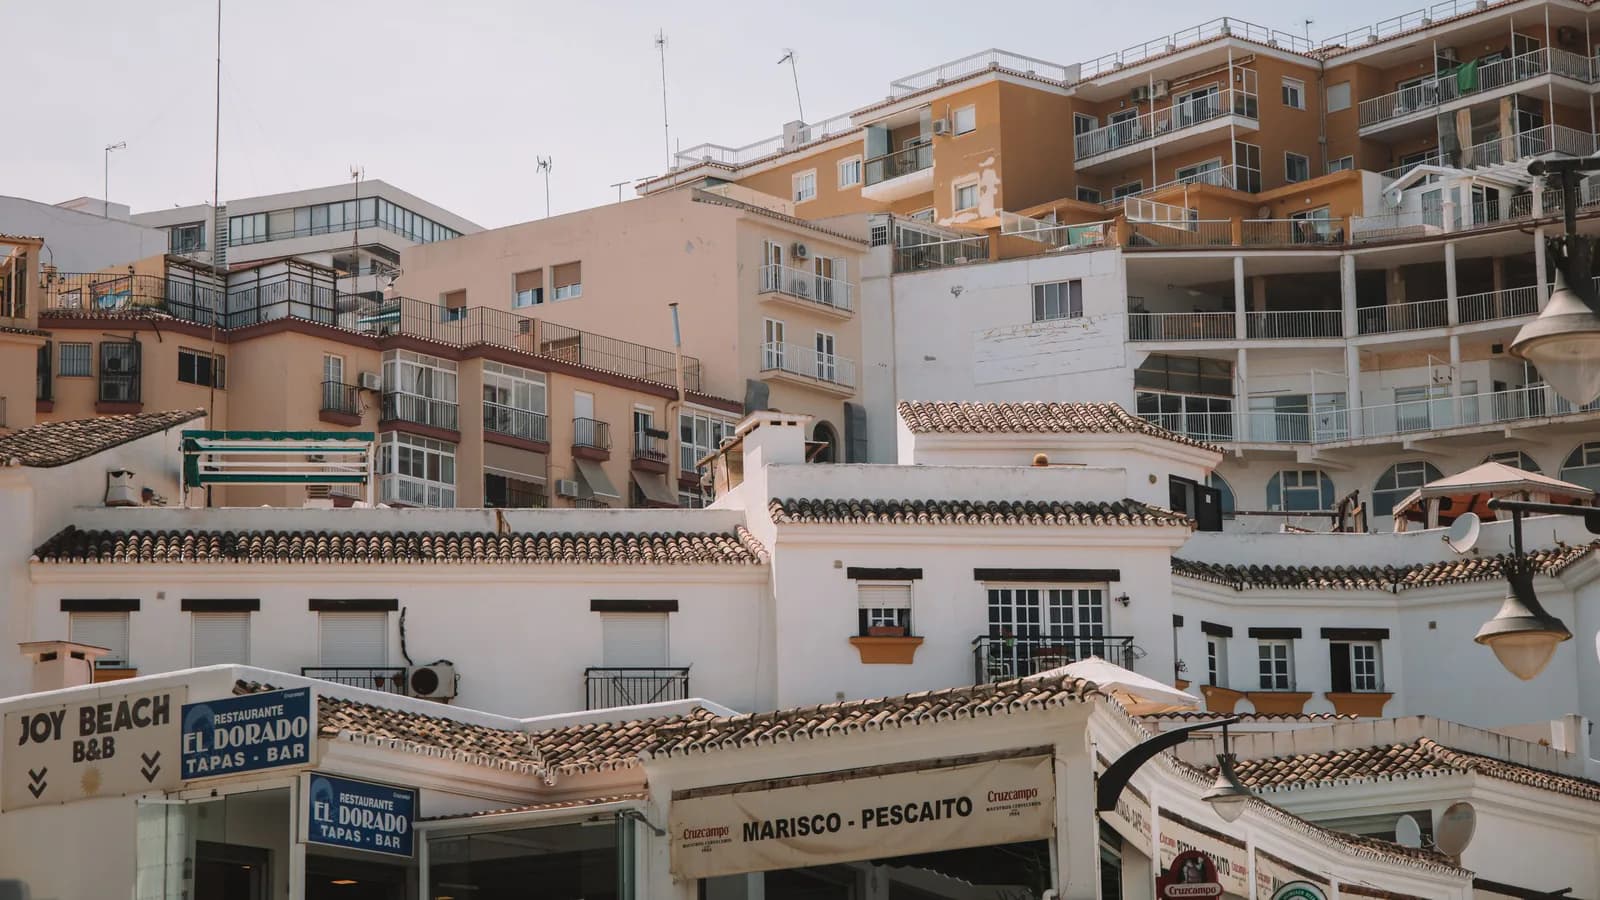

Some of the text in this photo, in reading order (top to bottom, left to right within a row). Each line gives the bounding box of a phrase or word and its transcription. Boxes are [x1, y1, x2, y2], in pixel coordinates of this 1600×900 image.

[19, 694, 170, 746] JOY BEACH
[213, 704, 284, 725] RESTAURANTE
[183, 716, 308, 754] EL DORADO
[72, 736, 115, 763] B&B
[186, 751, 246, 773] TAPAS
[266, 743, 305, 762] BAR
[340, 792, 394, 811] RESTAURANTE
[987, 788, 1038, 803] Cruzcampo
[313, 801, 408, 834] EL DORADO
[742, 811, 842, 843] MARISCO
[861, 796, 973, 829] PESCAITO
[321, 825, 361, 842] TAPAS
[375, 833, 401, 849] BAR
[683, 826, 729, 840] Cruzcampo
[1168, 885, 1217, 895] Cruzcampo
